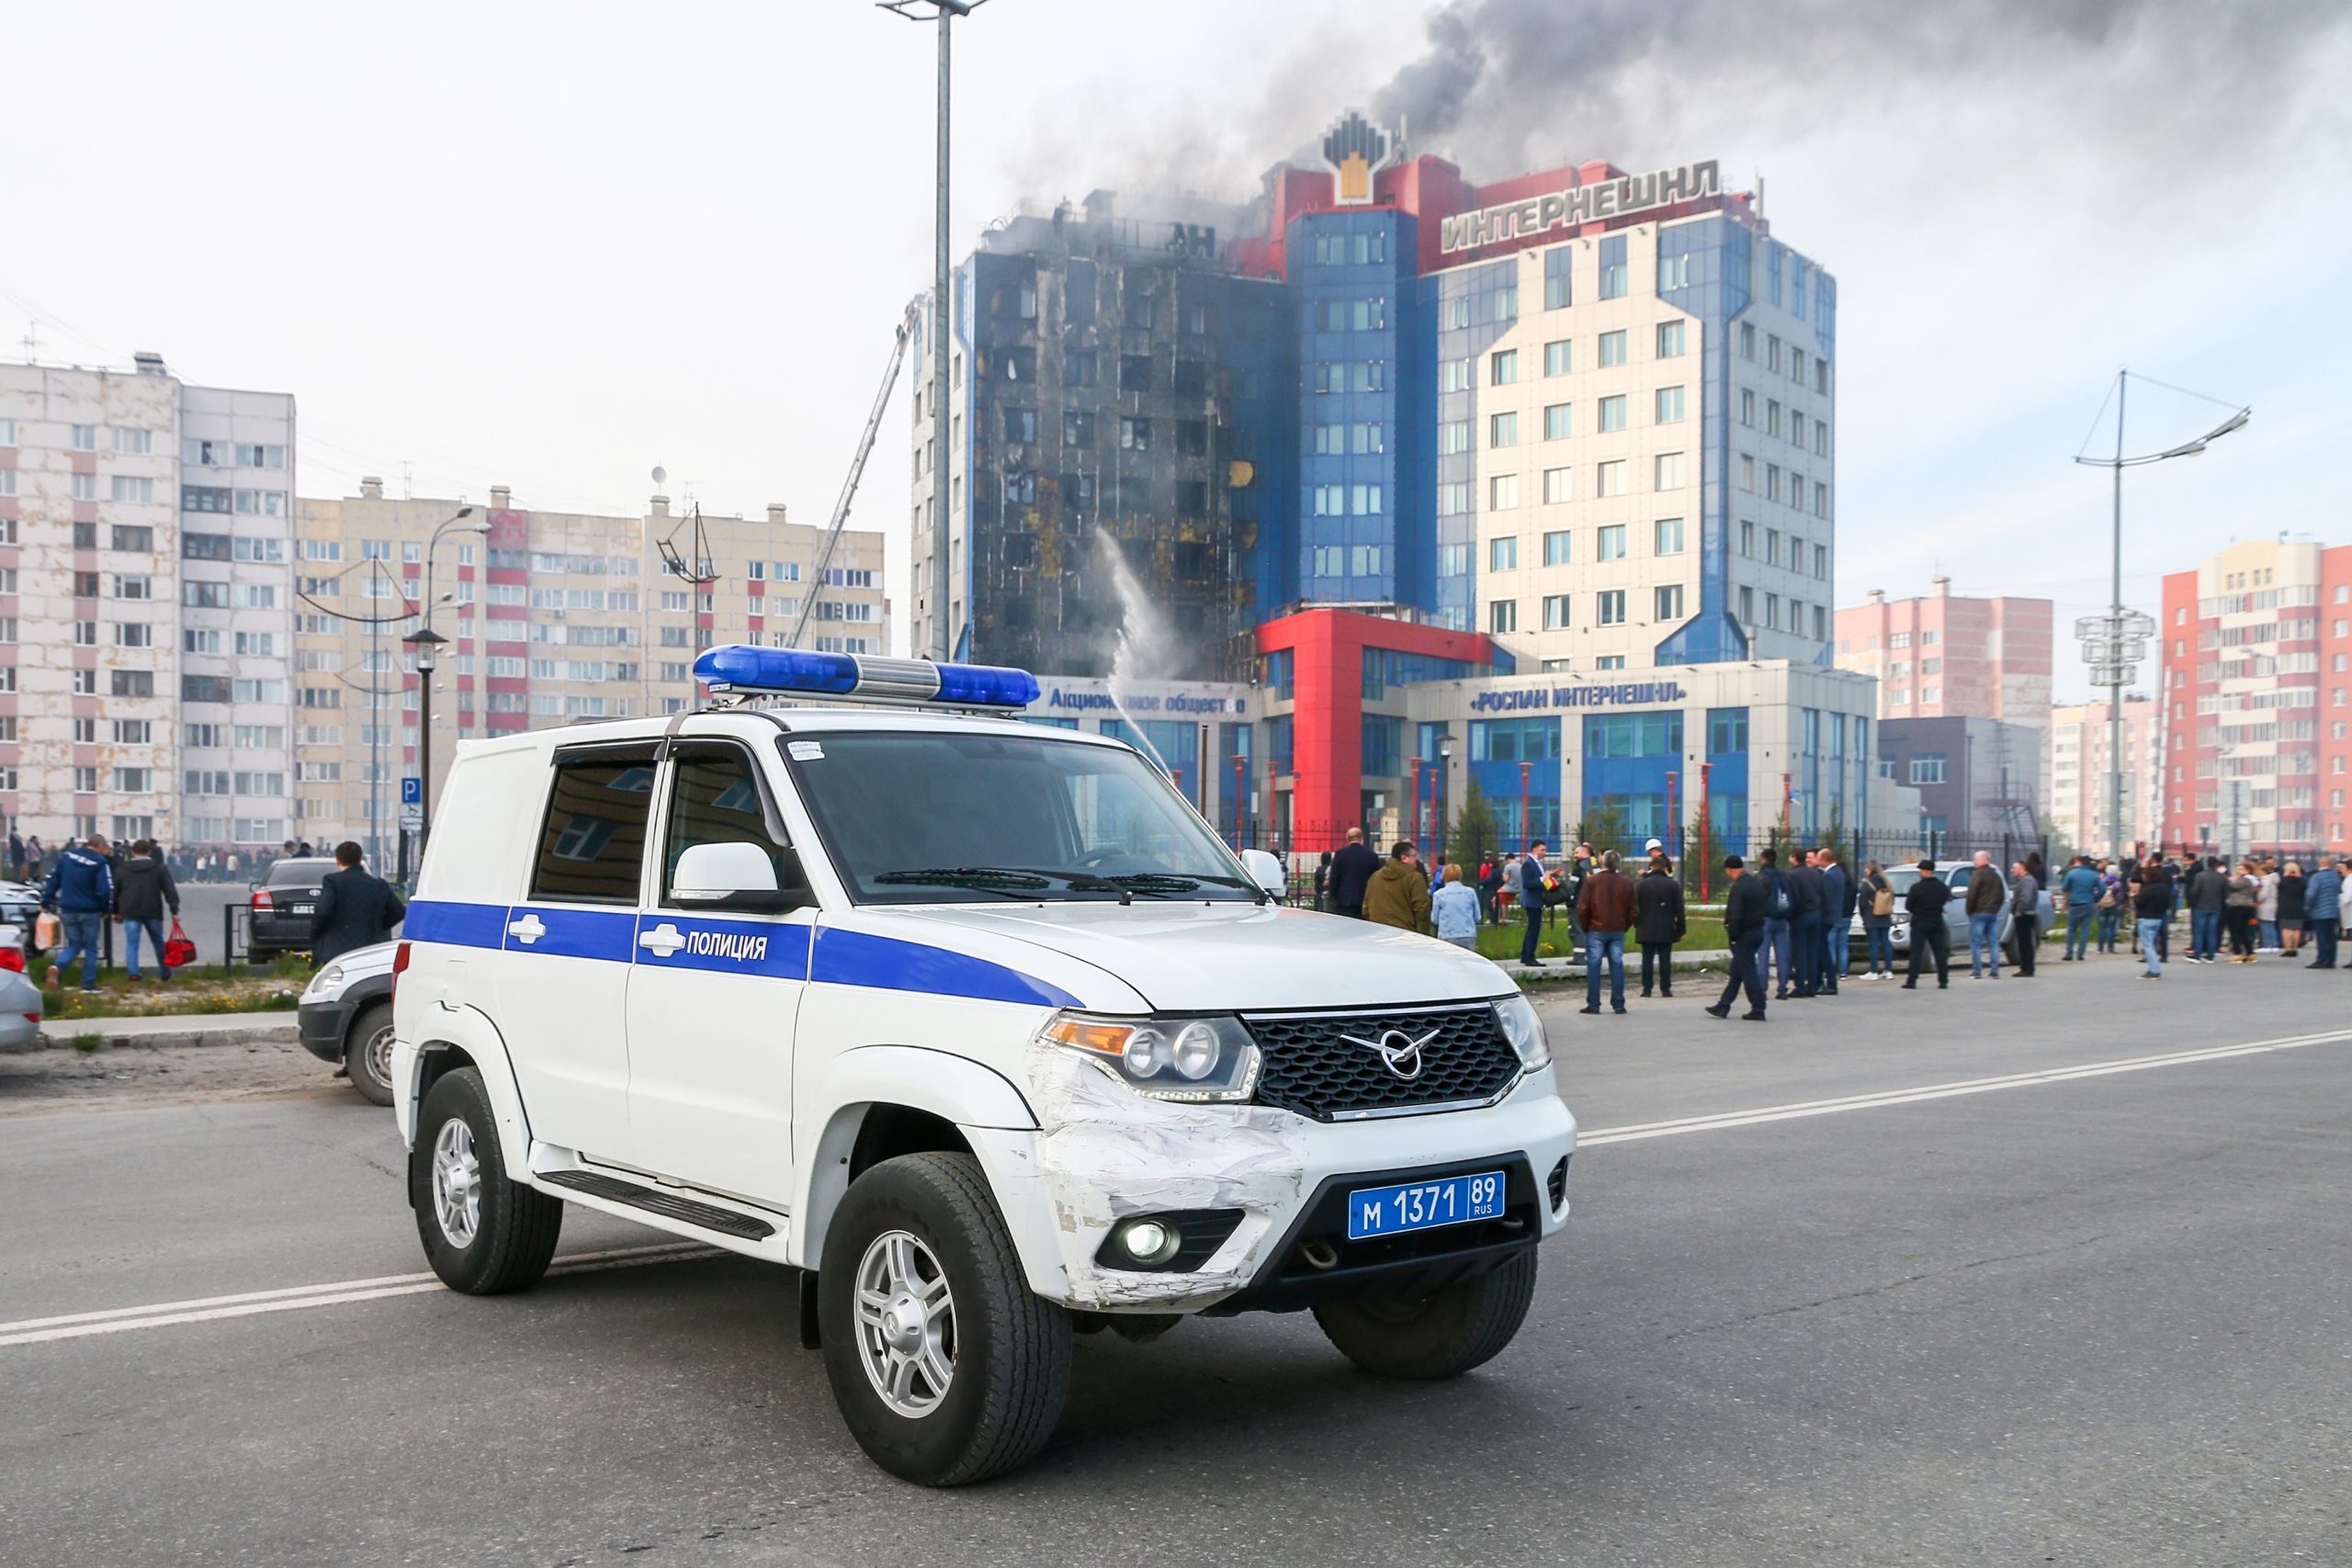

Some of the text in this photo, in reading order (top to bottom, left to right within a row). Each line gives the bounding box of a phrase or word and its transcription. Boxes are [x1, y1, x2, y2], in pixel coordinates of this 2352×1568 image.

[1442, 159, 1719, 254] ИНТЕРНЕШНЛ
[1166, 693, 1245, 714] общество
[405, 781, 416, 801] P
[687, 931, 767, 962] ПОЛИЦИЯ
[1394, 1184, 1455, 1225] 1371
[1472, 1177, 1496, 1204] 89
[1475, 1204, 1493, 1215] RUS
